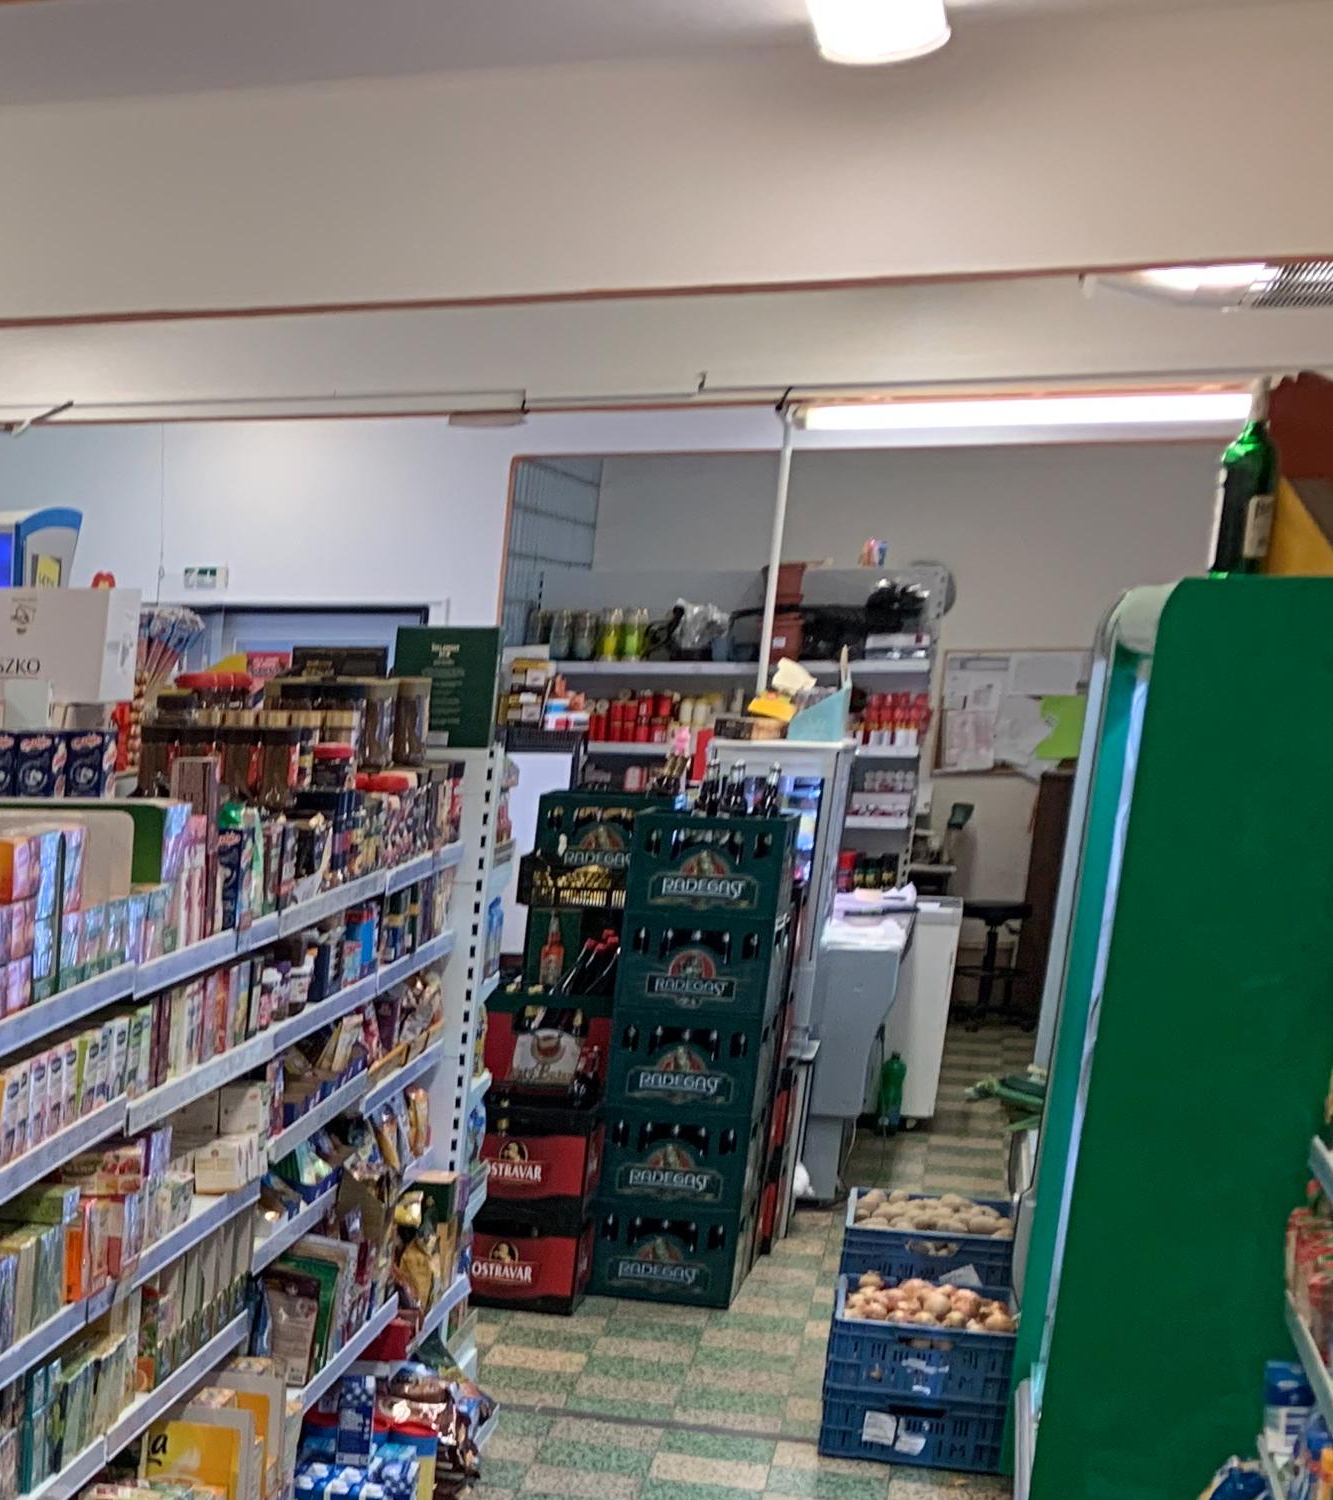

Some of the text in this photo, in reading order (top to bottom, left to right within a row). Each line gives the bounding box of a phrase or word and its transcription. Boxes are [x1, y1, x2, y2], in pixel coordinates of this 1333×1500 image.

[662, 876, 746, 900] RADEGAST
[654, 977, 729, 996] RADEGAST
[639, 1071, 722, 1094] RADEGAST
[629, 1167, 711, 1193] RADEGAST
[471, 1262, 533, 1284] OSTRAVAR
